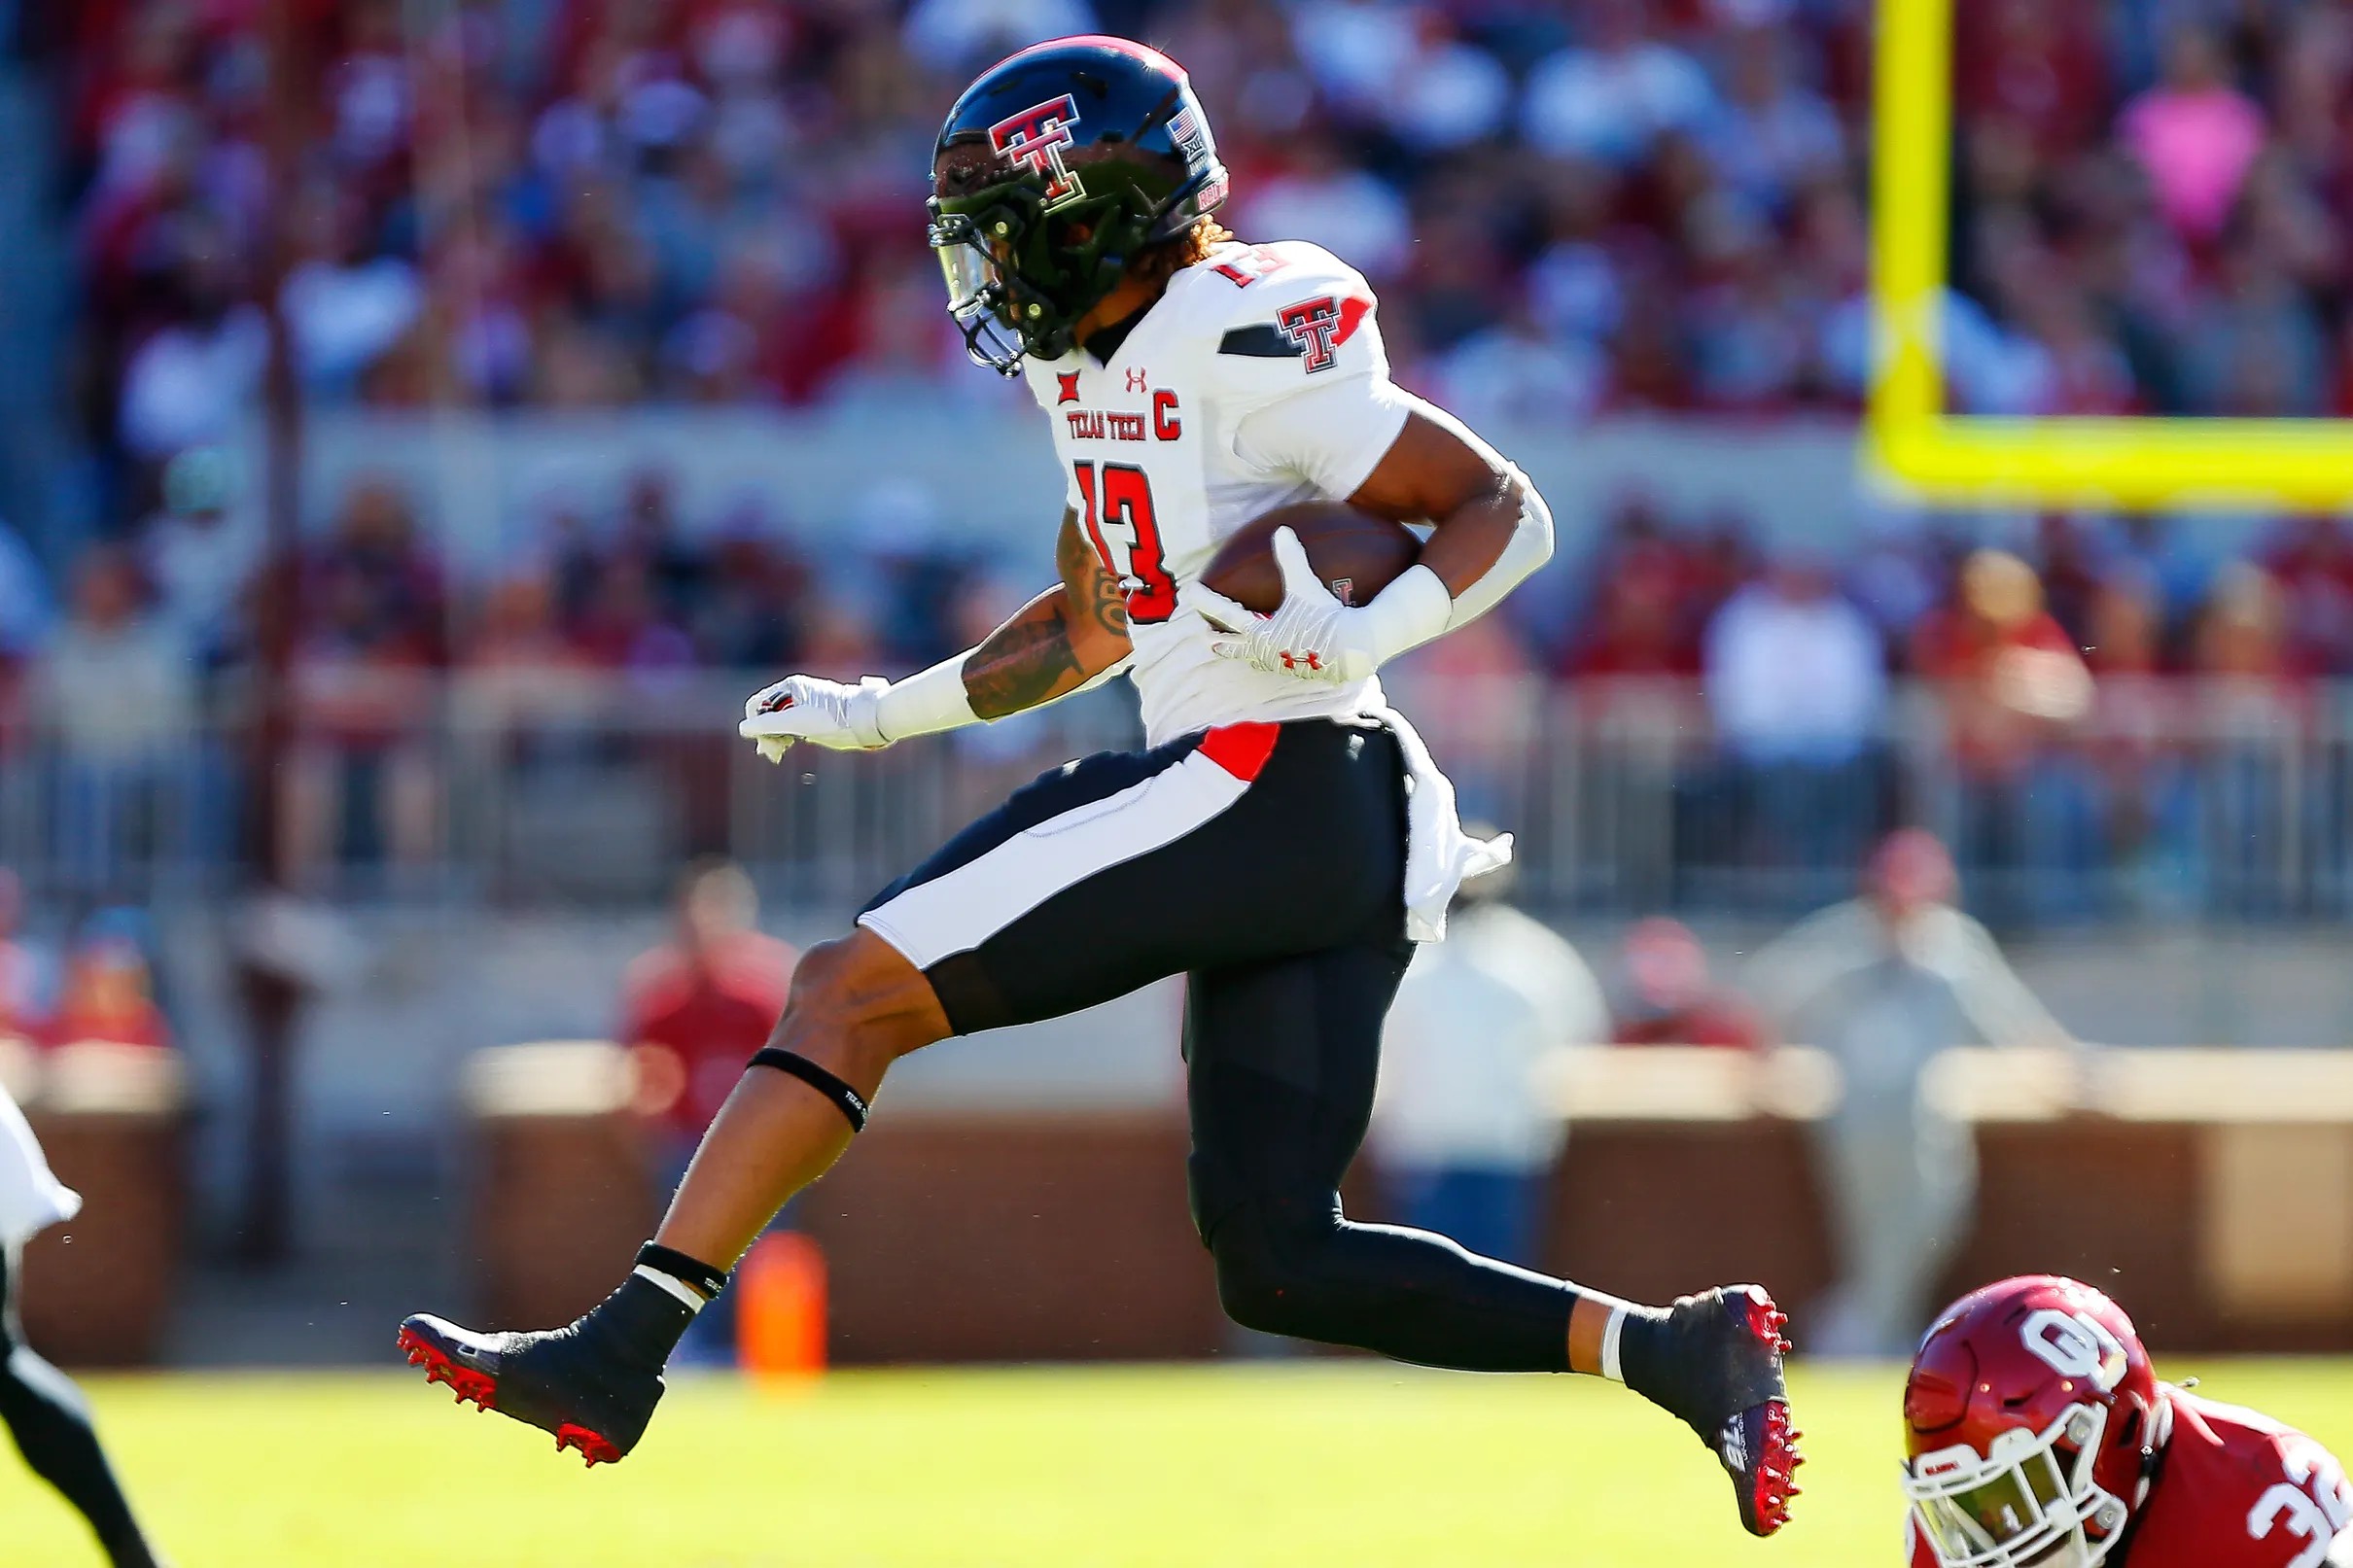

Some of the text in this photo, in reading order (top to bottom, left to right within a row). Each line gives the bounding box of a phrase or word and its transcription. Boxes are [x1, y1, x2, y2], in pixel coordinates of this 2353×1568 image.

[1067, 409, 1147, 441] TEXAS TECH
[1152, 388, 1181, 441] C
[1072, 458, 1179, 625] 13
[2019, 1308, 2128, 1391] OU
